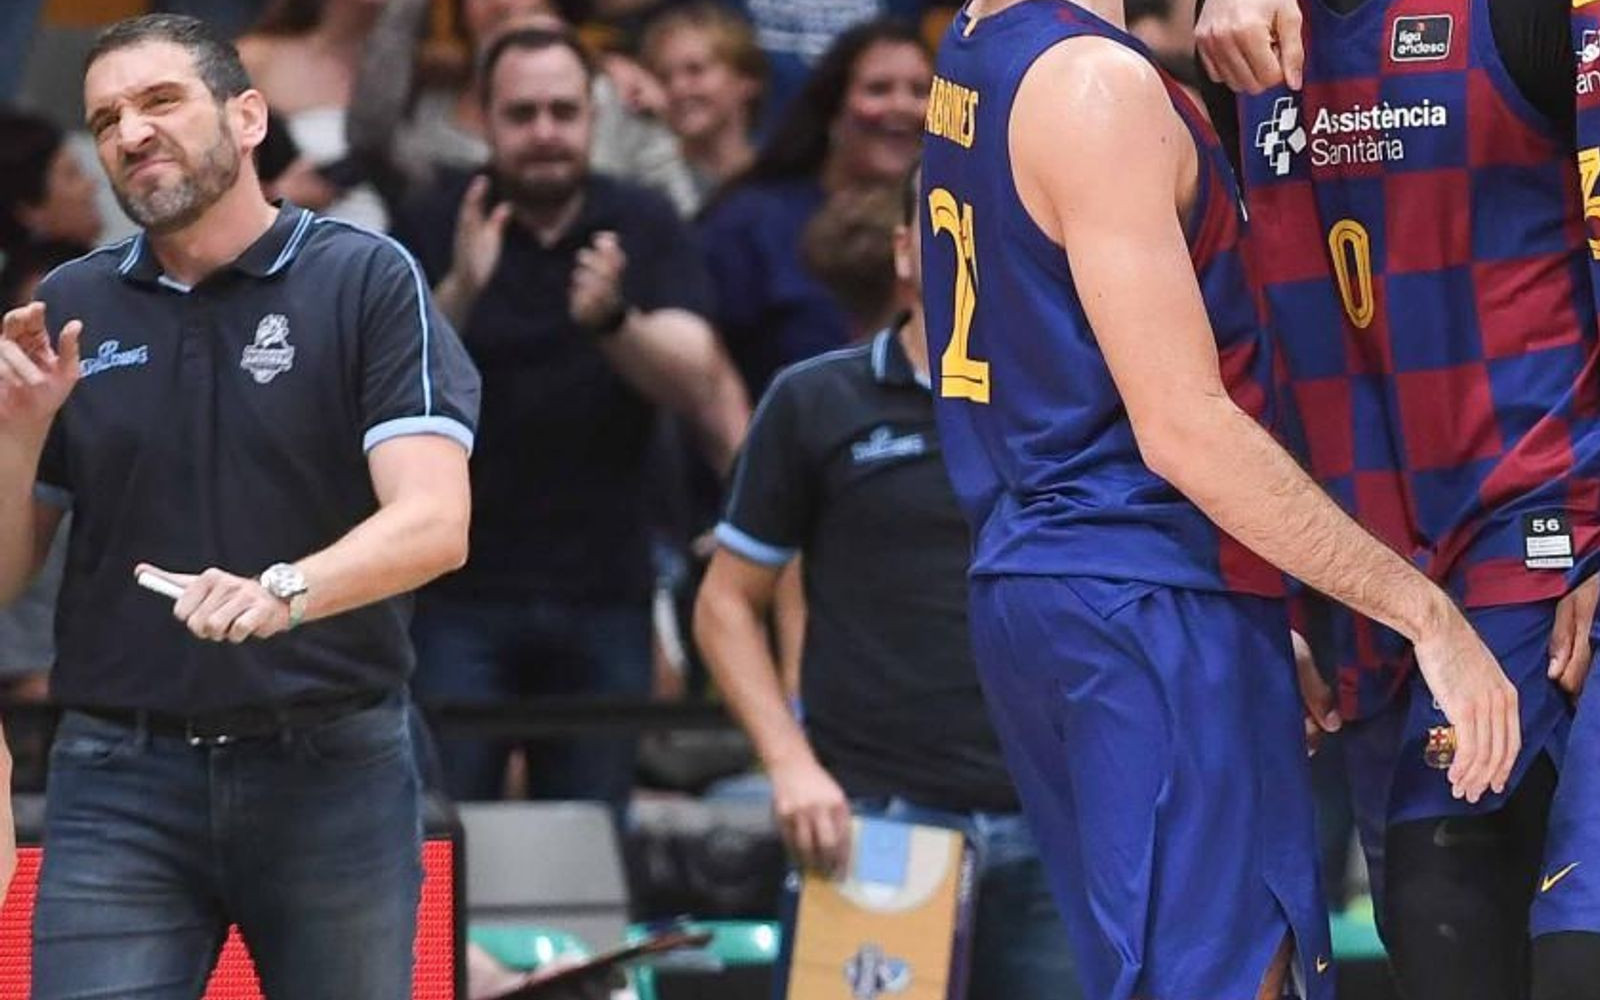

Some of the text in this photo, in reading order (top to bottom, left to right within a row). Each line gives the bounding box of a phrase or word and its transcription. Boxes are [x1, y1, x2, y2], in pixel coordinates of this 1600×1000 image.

[1398, 30, 1422, 45] liga
[1311, 99, 1447, 135] Assistència
[1311, 133, 1405, 166] Sanitària
[1328, 218, 1375, 329] 0
[1532, 519, 1560, 533] 56
